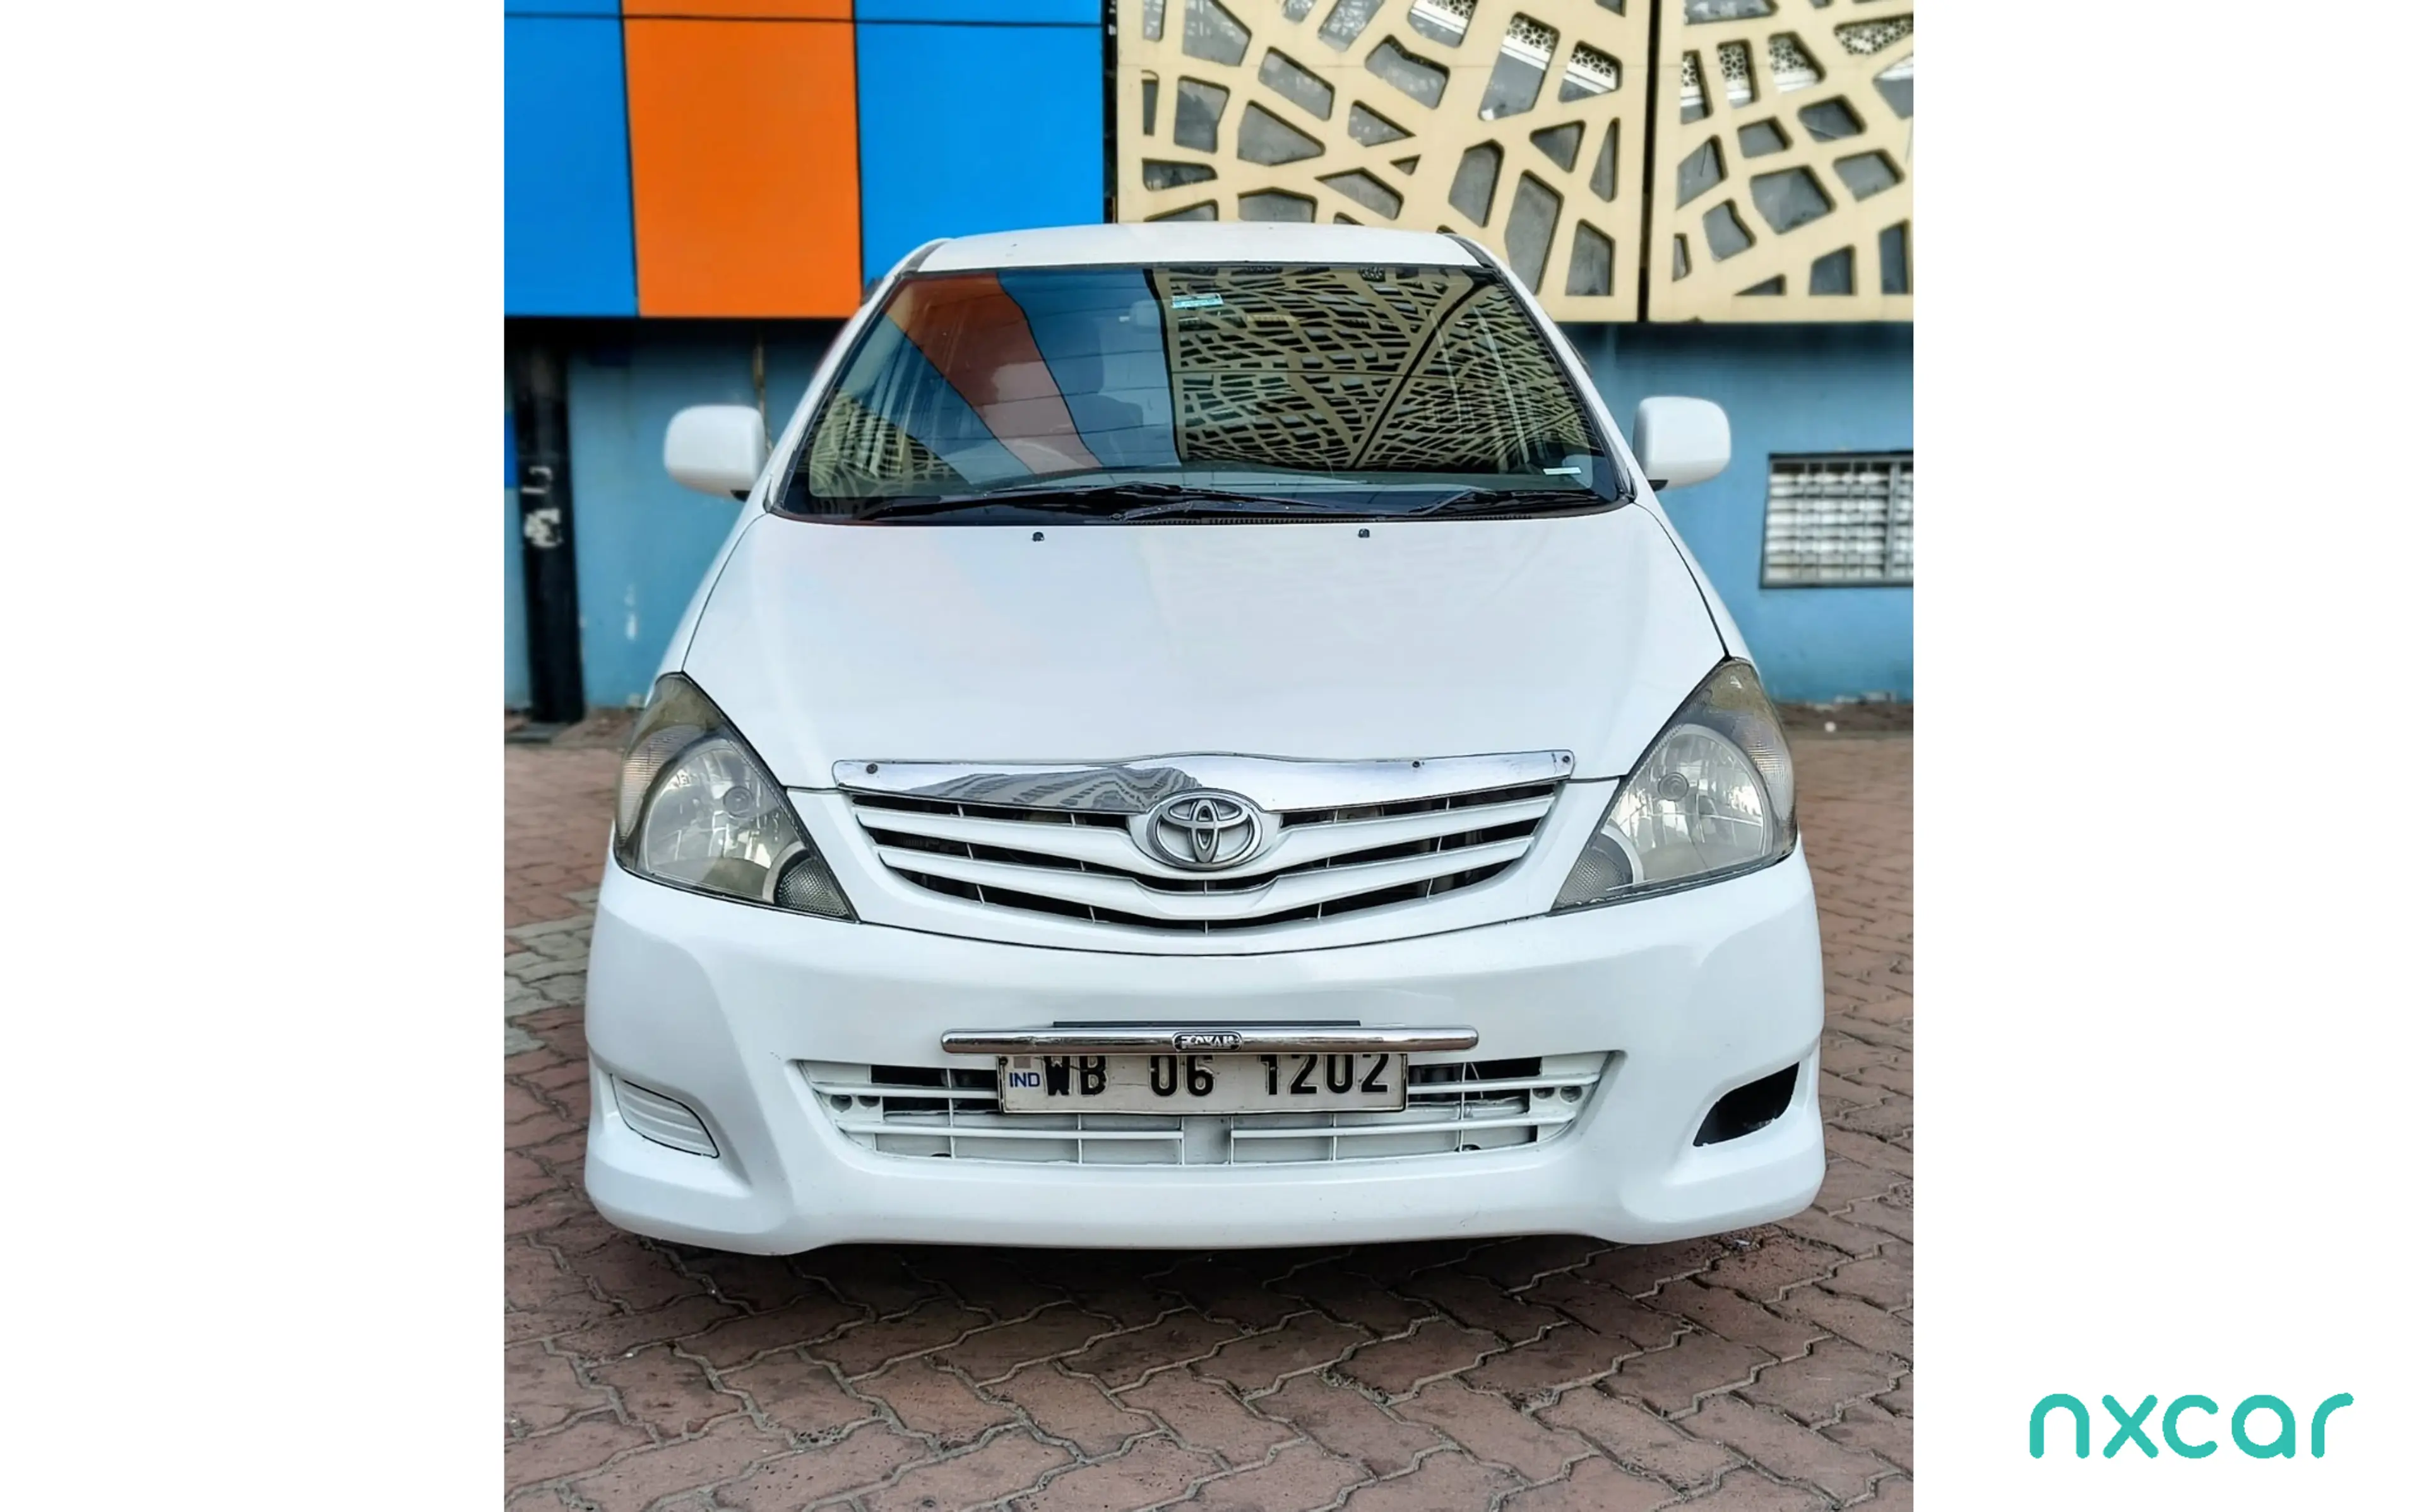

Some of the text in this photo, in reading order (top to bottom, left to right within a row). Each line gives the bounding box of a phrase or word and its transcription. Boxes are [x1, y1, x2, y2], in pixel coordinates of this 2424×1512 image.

[1009, 1072, 1040, 1088] IND
[1044, 1054, 1389, 1096] WB 06 1202
